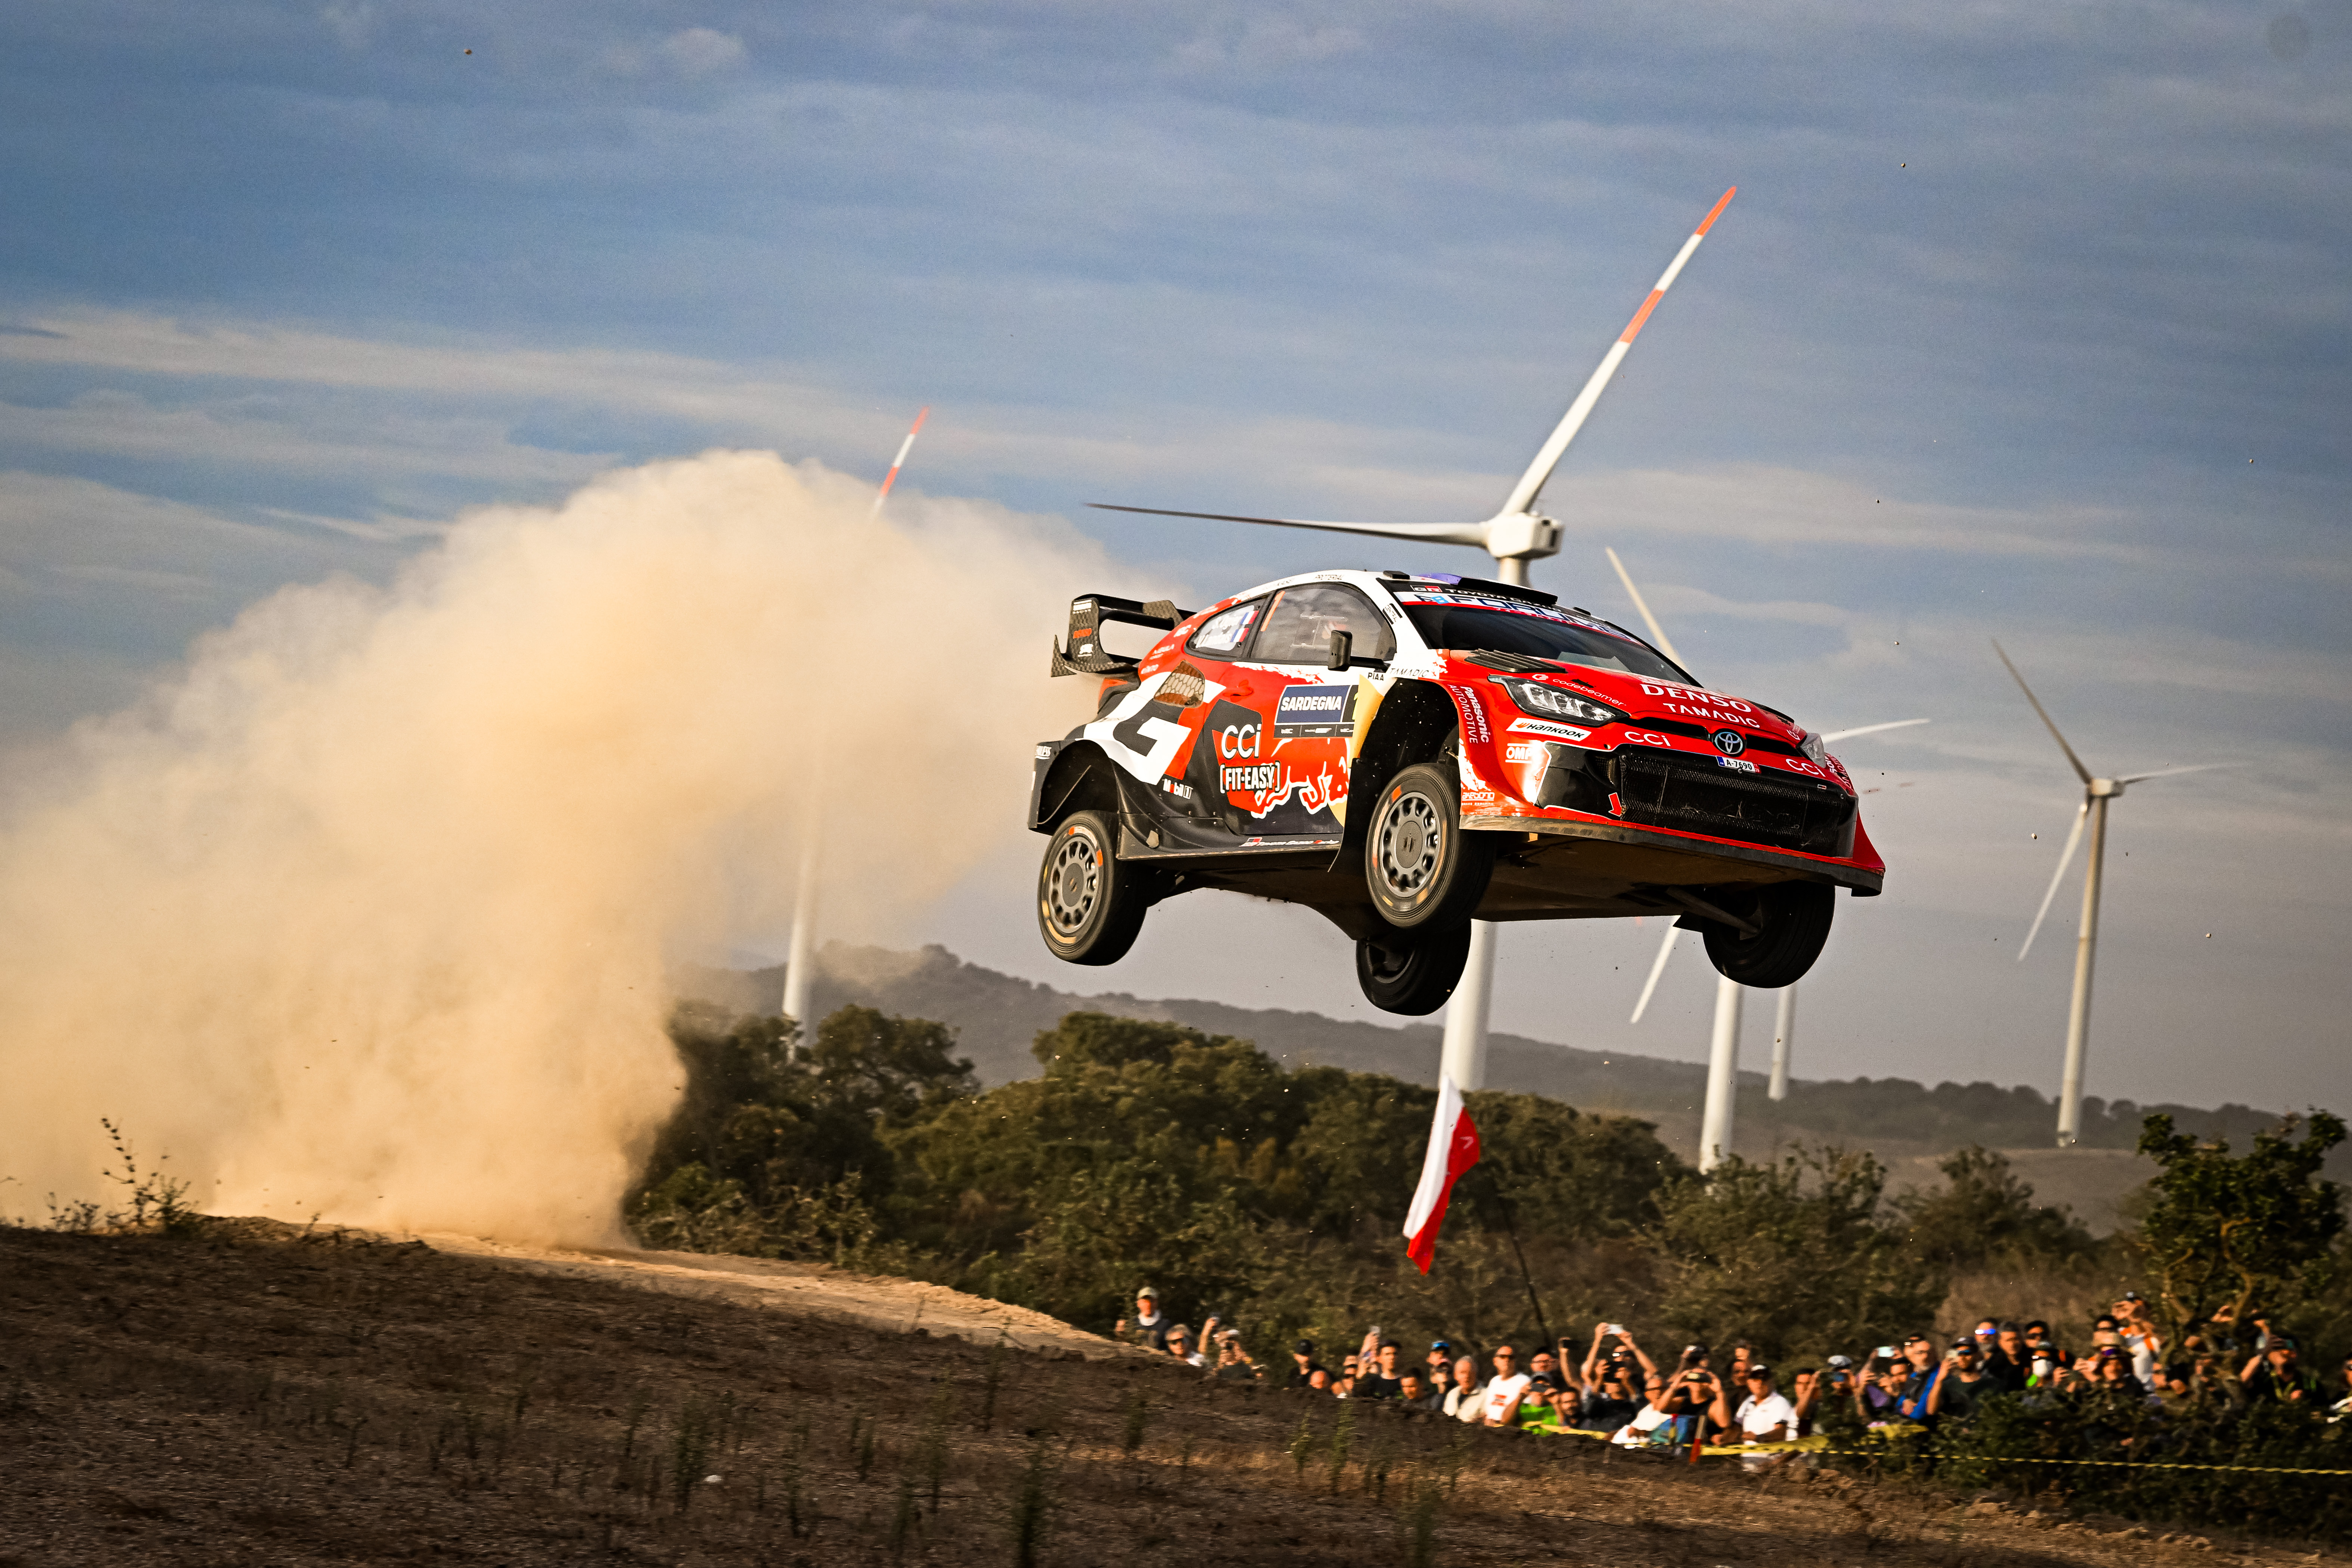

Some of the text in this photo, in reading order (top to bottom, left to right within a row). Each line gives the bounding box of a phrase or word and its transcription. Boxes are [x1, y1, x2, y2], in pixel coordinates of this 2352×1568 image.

[1445, 589, 1507, 600] TOYOTA
[1368, 672, 1384, 681] PIAA
[1390, 668, 1429, 677] TAMADIC
[1552, 679, 1624, 706] codebeamer
[1640, 684, 1751, 712] DENSO
[1281, 696, 1342, 711] SARDEGNA
[1447, 684, 1478, 744] AUTOMOTIVE
[1460, 686, 1489, 743] Panasonic
[1663, 703, 1760, 728] TAMADIC
[1726, 759, 1752, 770] A-7690
[1163, 778, 1184, 797] Mobil
